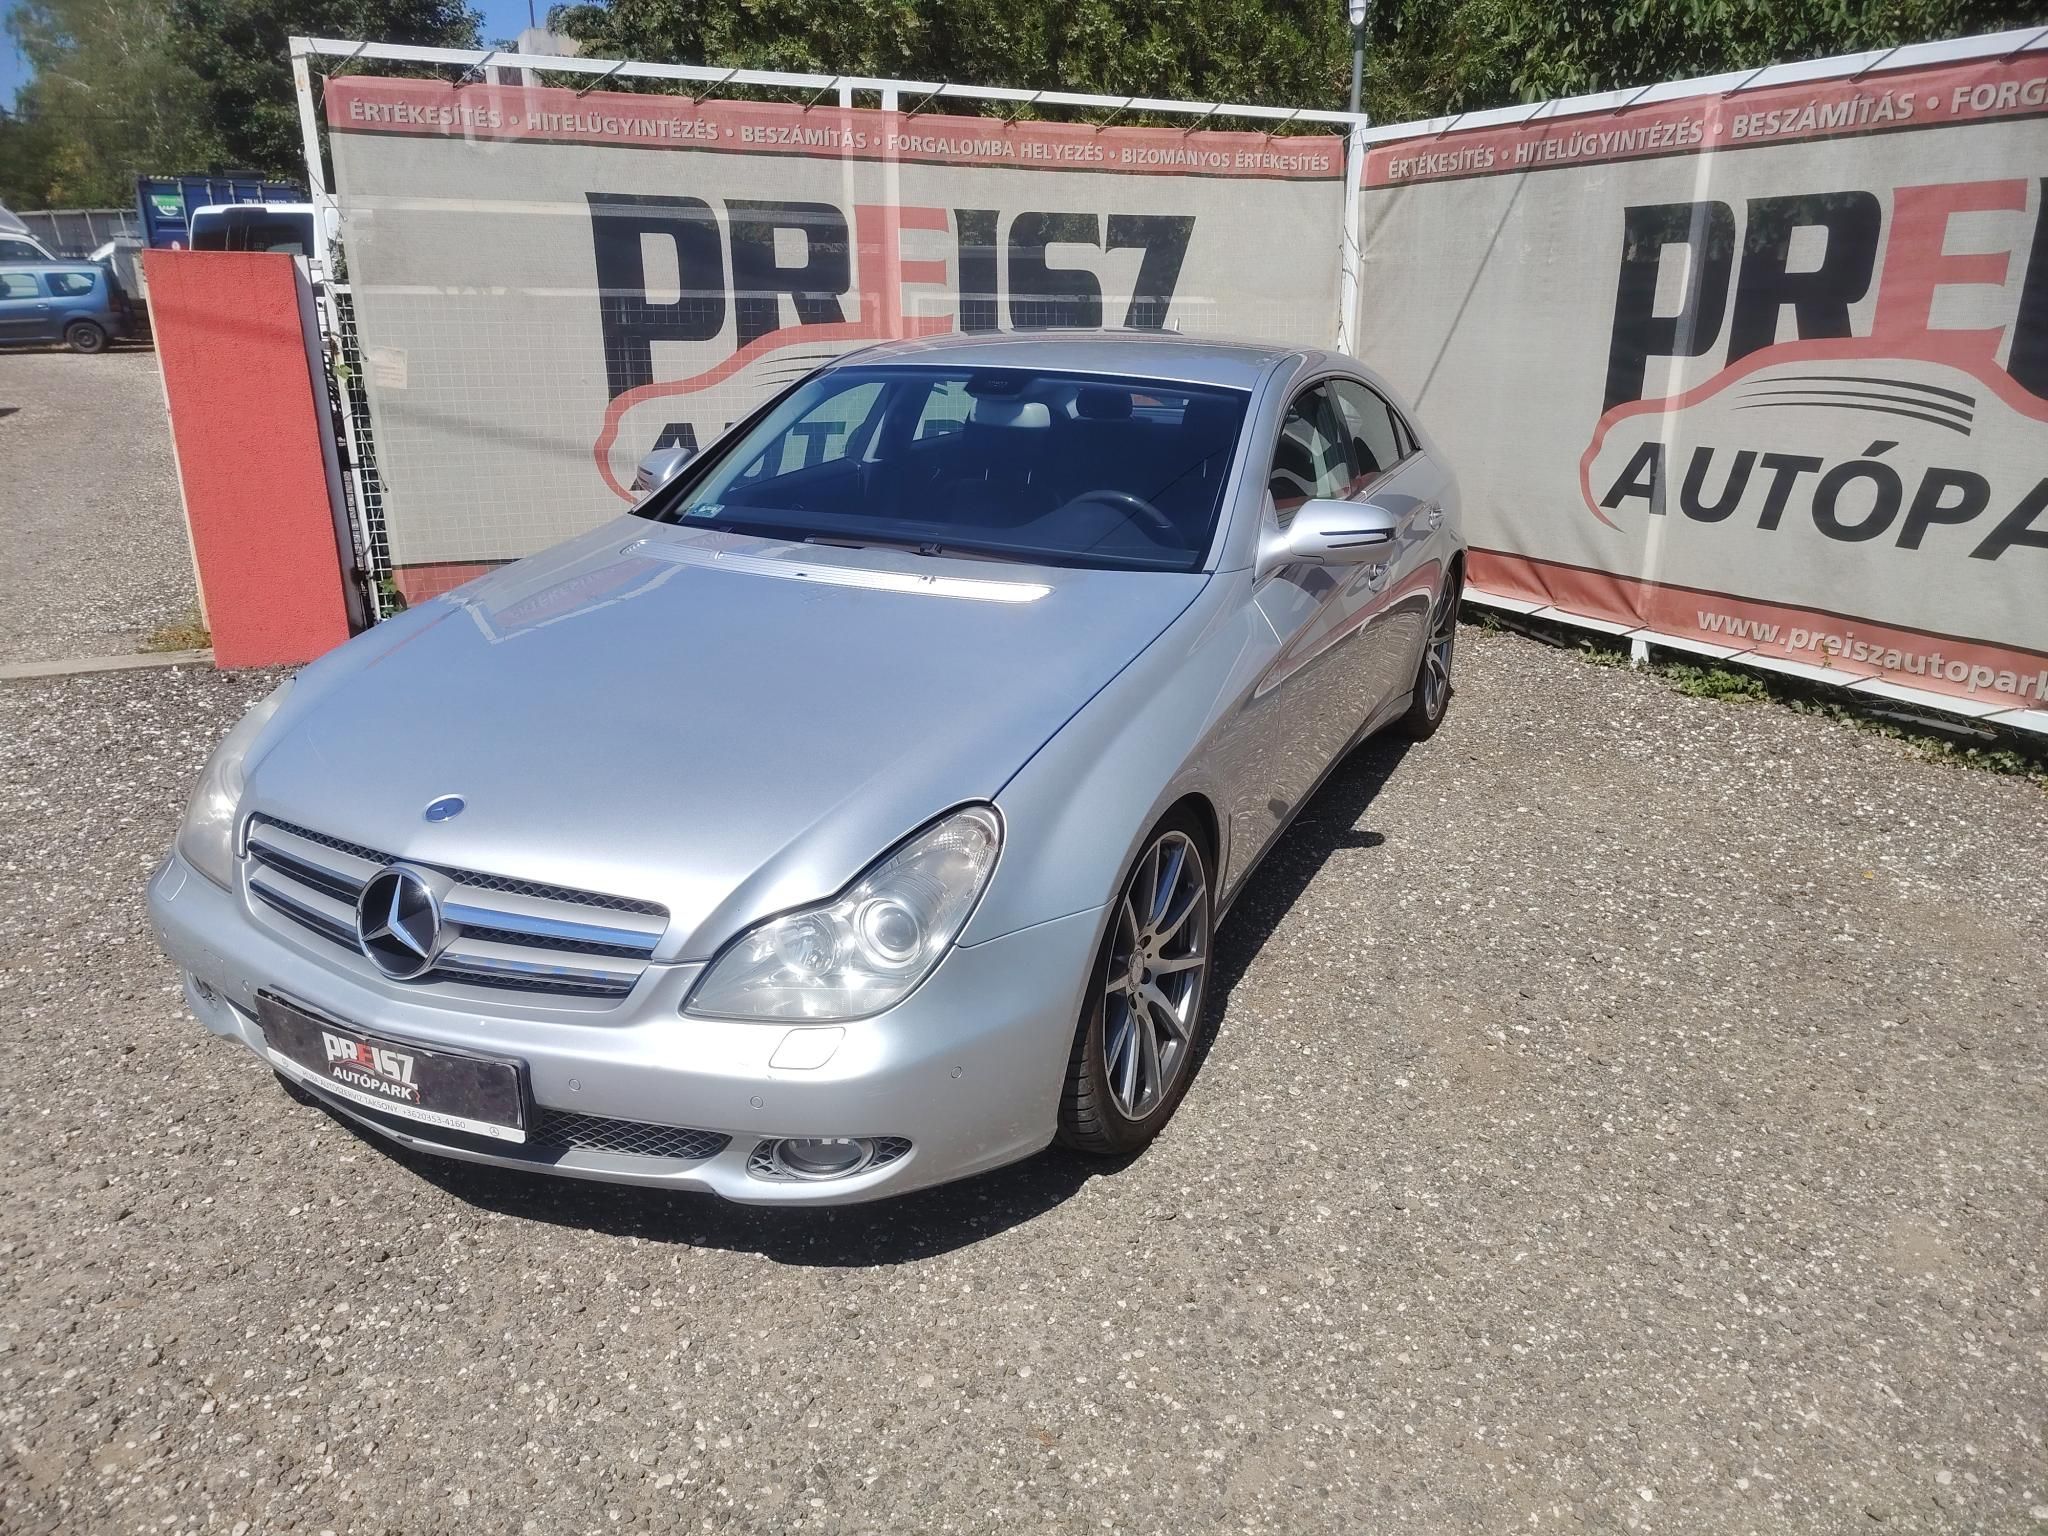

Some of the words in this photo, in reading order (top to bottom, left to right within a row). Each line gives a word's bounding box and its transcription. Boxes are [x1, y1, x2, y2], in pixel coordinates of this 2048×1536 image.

[350, 98, 502, 129] ÉRTÉKESÍTÉS
[527, 111, 720, 141] HITELÜGYINTÉZÉS
[741, 124, 868, 149] BESZÁMÍTÁS
[887, 133, 1016, 157] FORGALOMBA
[1020, 141, 1105, 162] HELYEZÉS
[1121, 147, 1230, 168] BIZOMÁNYOS
[1235, 150, 1329, 172] ÉRTÉKESÍTÉS
[1388, 146, 1495, 180] ÉRTÉKESÍTÉS
[1515, 119, 1705, 164] HITELÜGYINTÉZÉS
[1730, 91, 1914, 141] BESZÁMÍTÁS
[322, 1031, 418, 1090] PREISZ
[333, 1066, 412, 1101] AUTÓPARK
